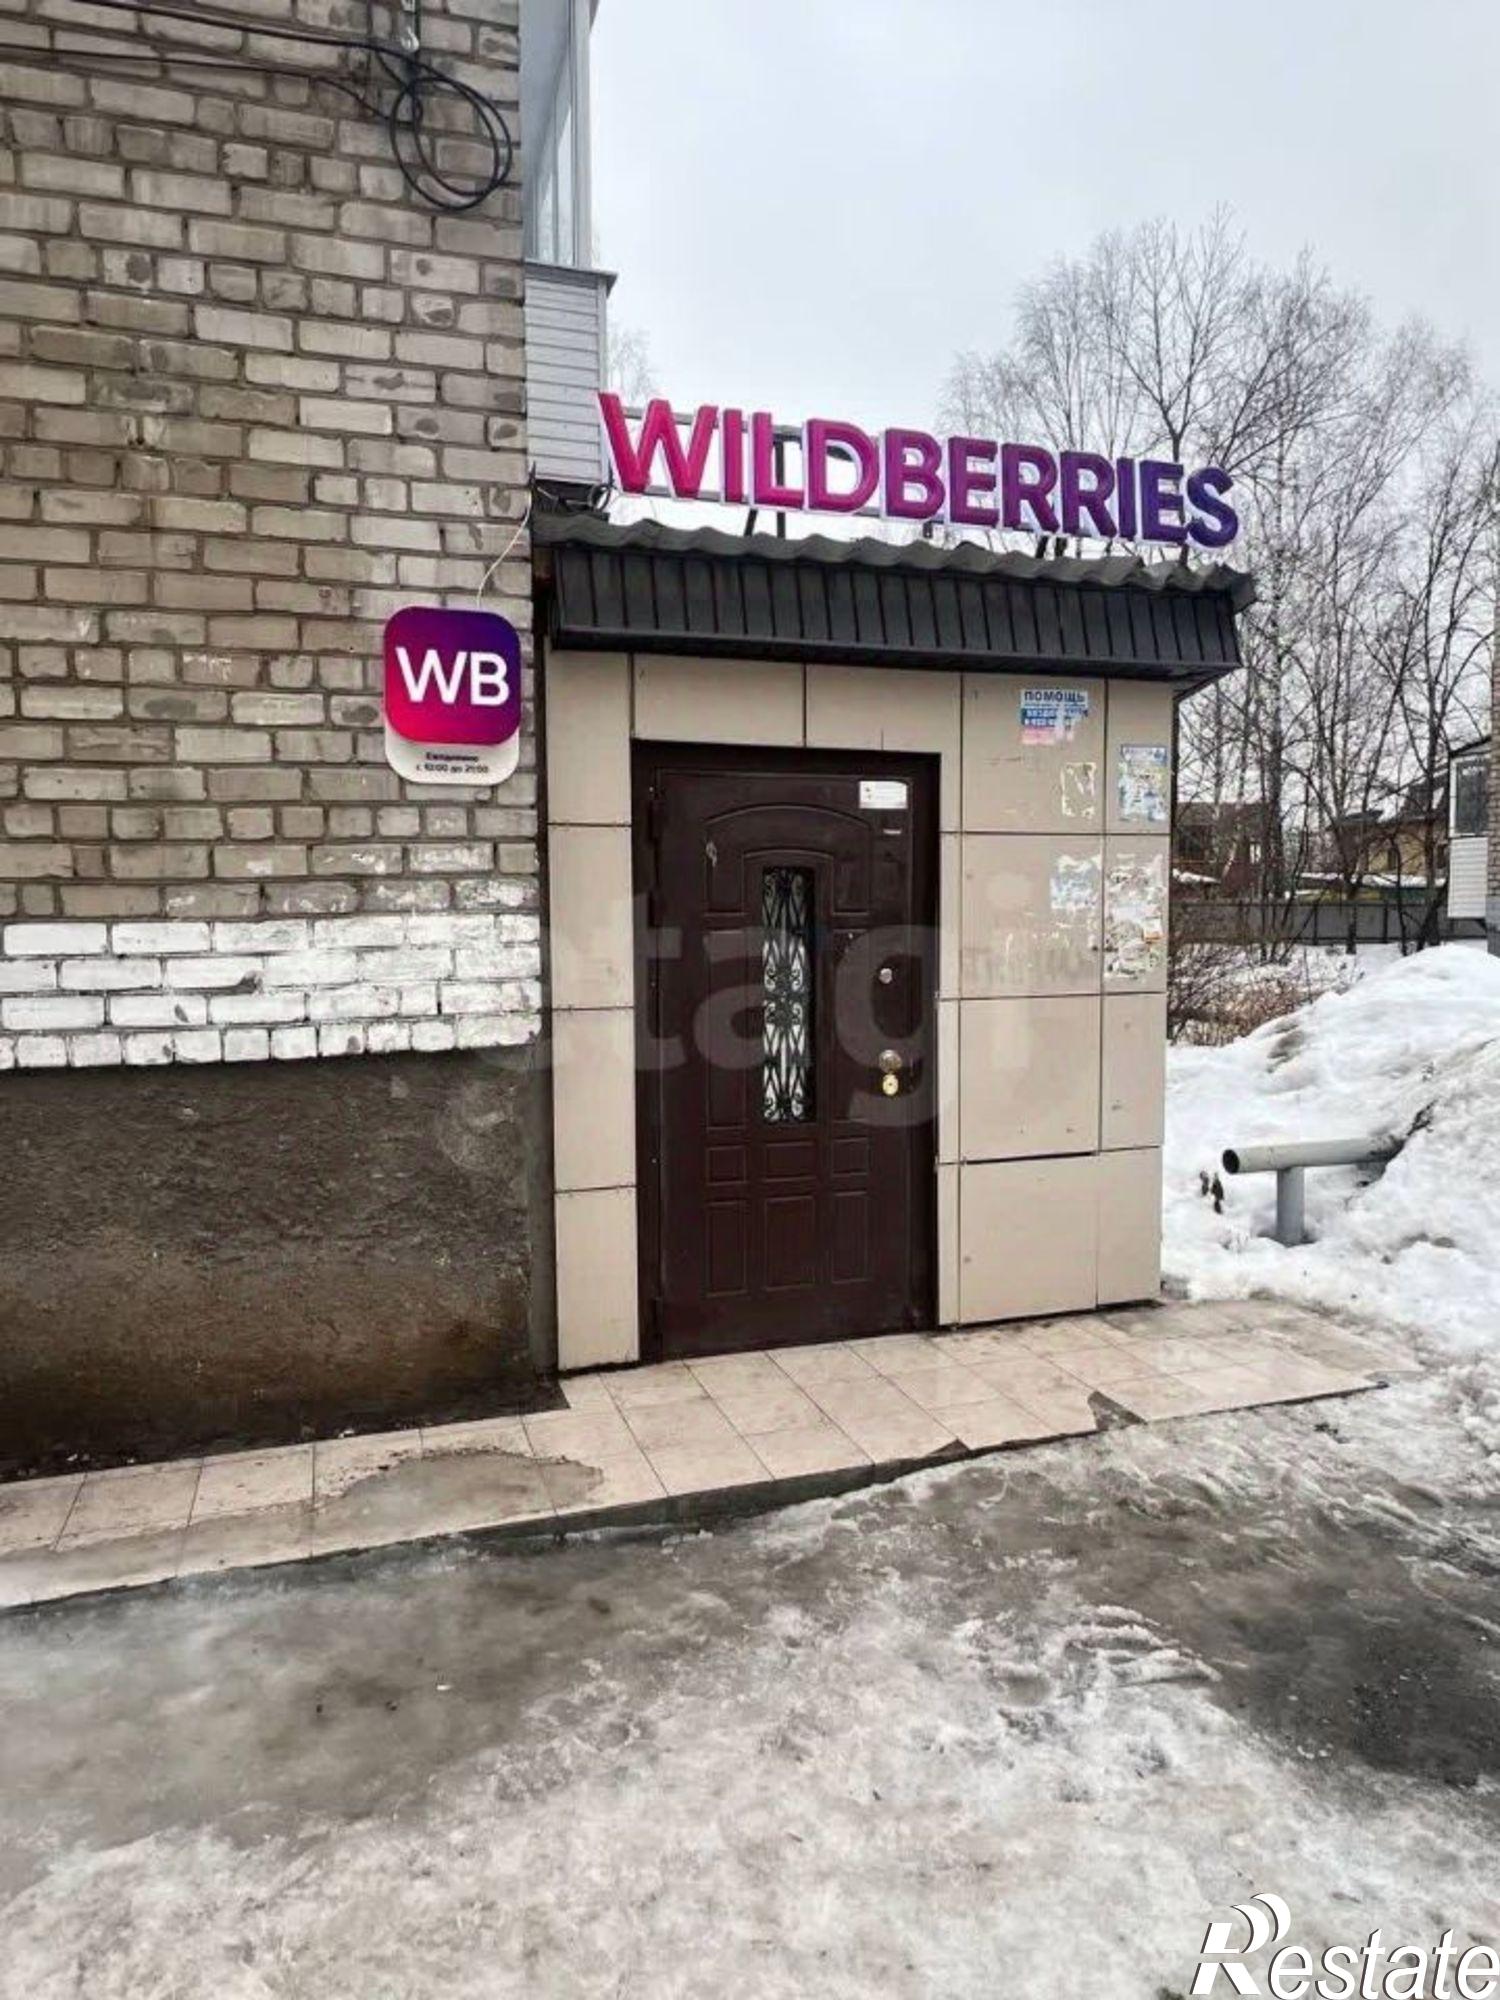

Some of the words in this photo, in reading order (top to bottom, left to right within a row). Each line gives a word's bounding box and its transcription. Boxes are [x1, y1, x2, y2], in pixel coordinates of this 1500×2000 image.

[597, 391, 1240, 549] WILDBERRIES
[395, 646, 510, 706] WB
[1024, 691, 1085, 703] ПОМОЩЬ
